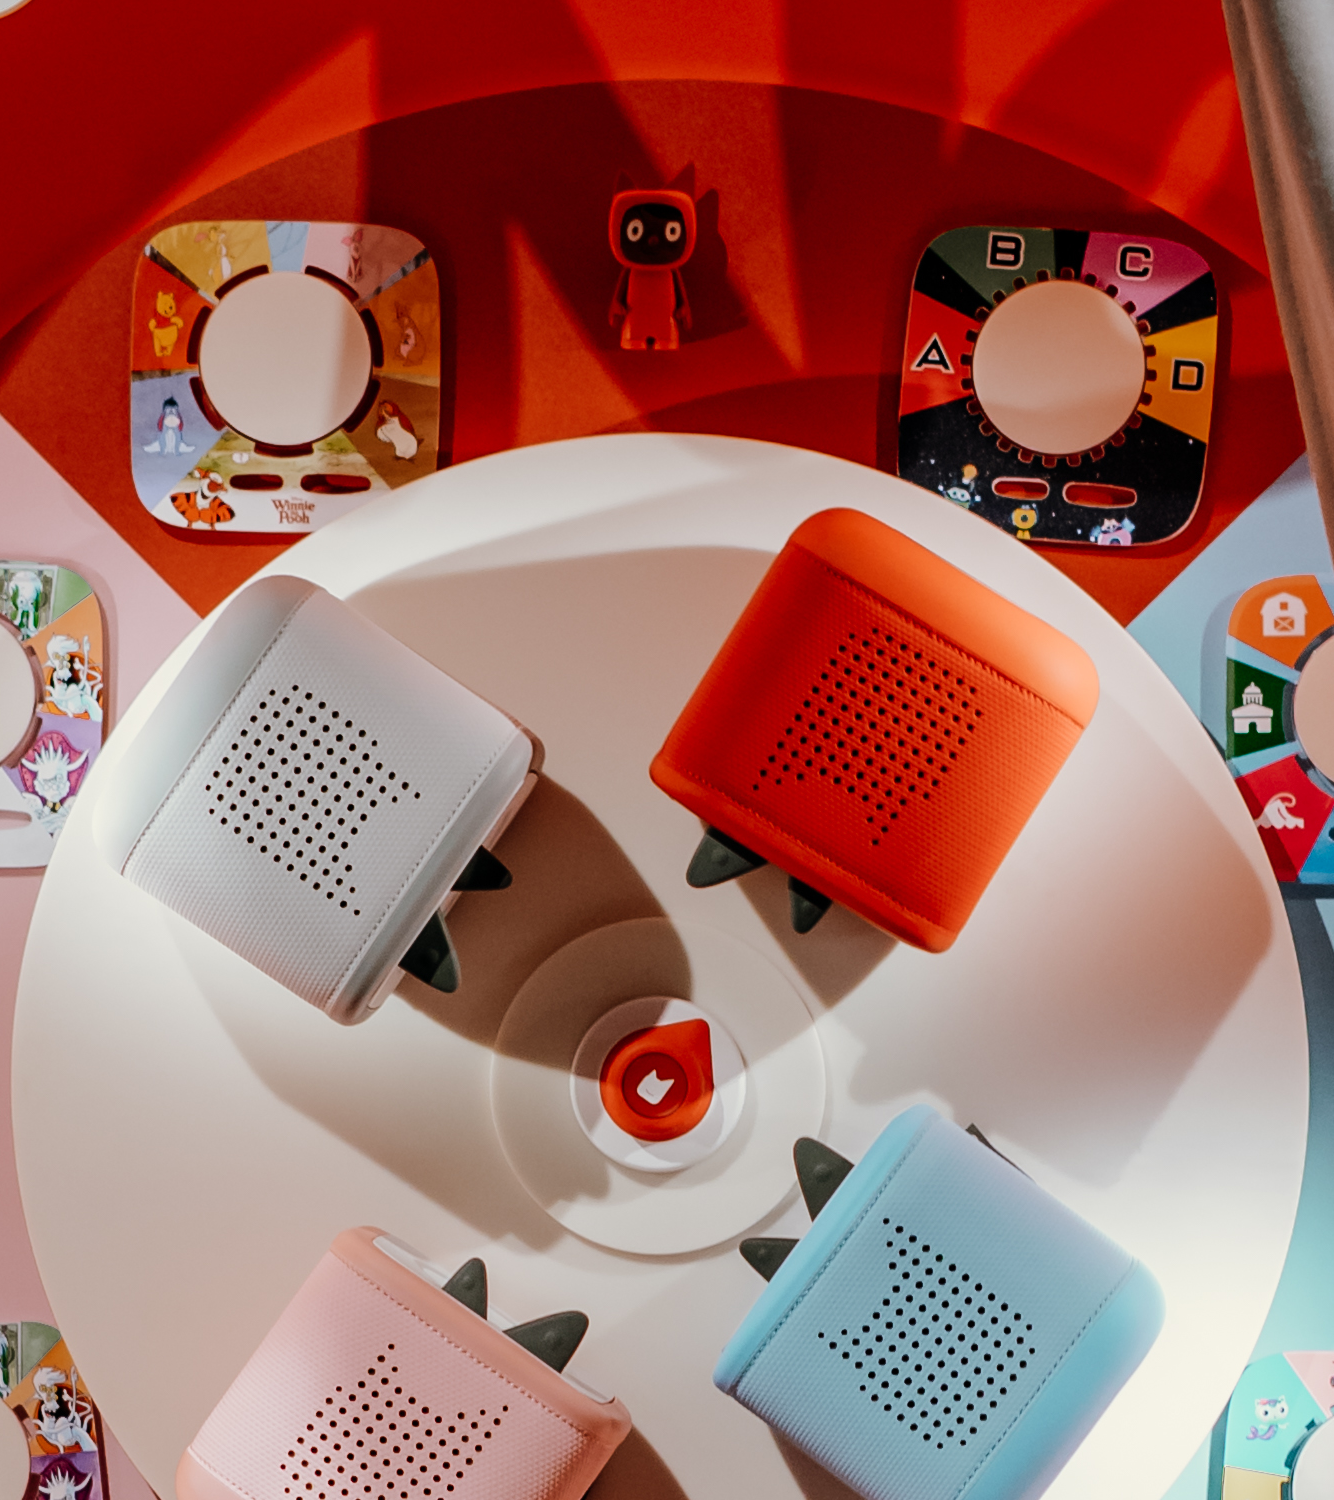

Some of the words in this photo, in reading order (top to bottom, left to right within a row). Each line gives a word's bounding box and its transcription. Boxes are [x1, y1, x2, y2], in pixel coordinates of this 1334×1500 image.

[987, 232, 1025, 270] B
[1116, 244, 1154, 280] C
[910, 333, 955, 373] A
[1170, 358, 1205, 392] D
